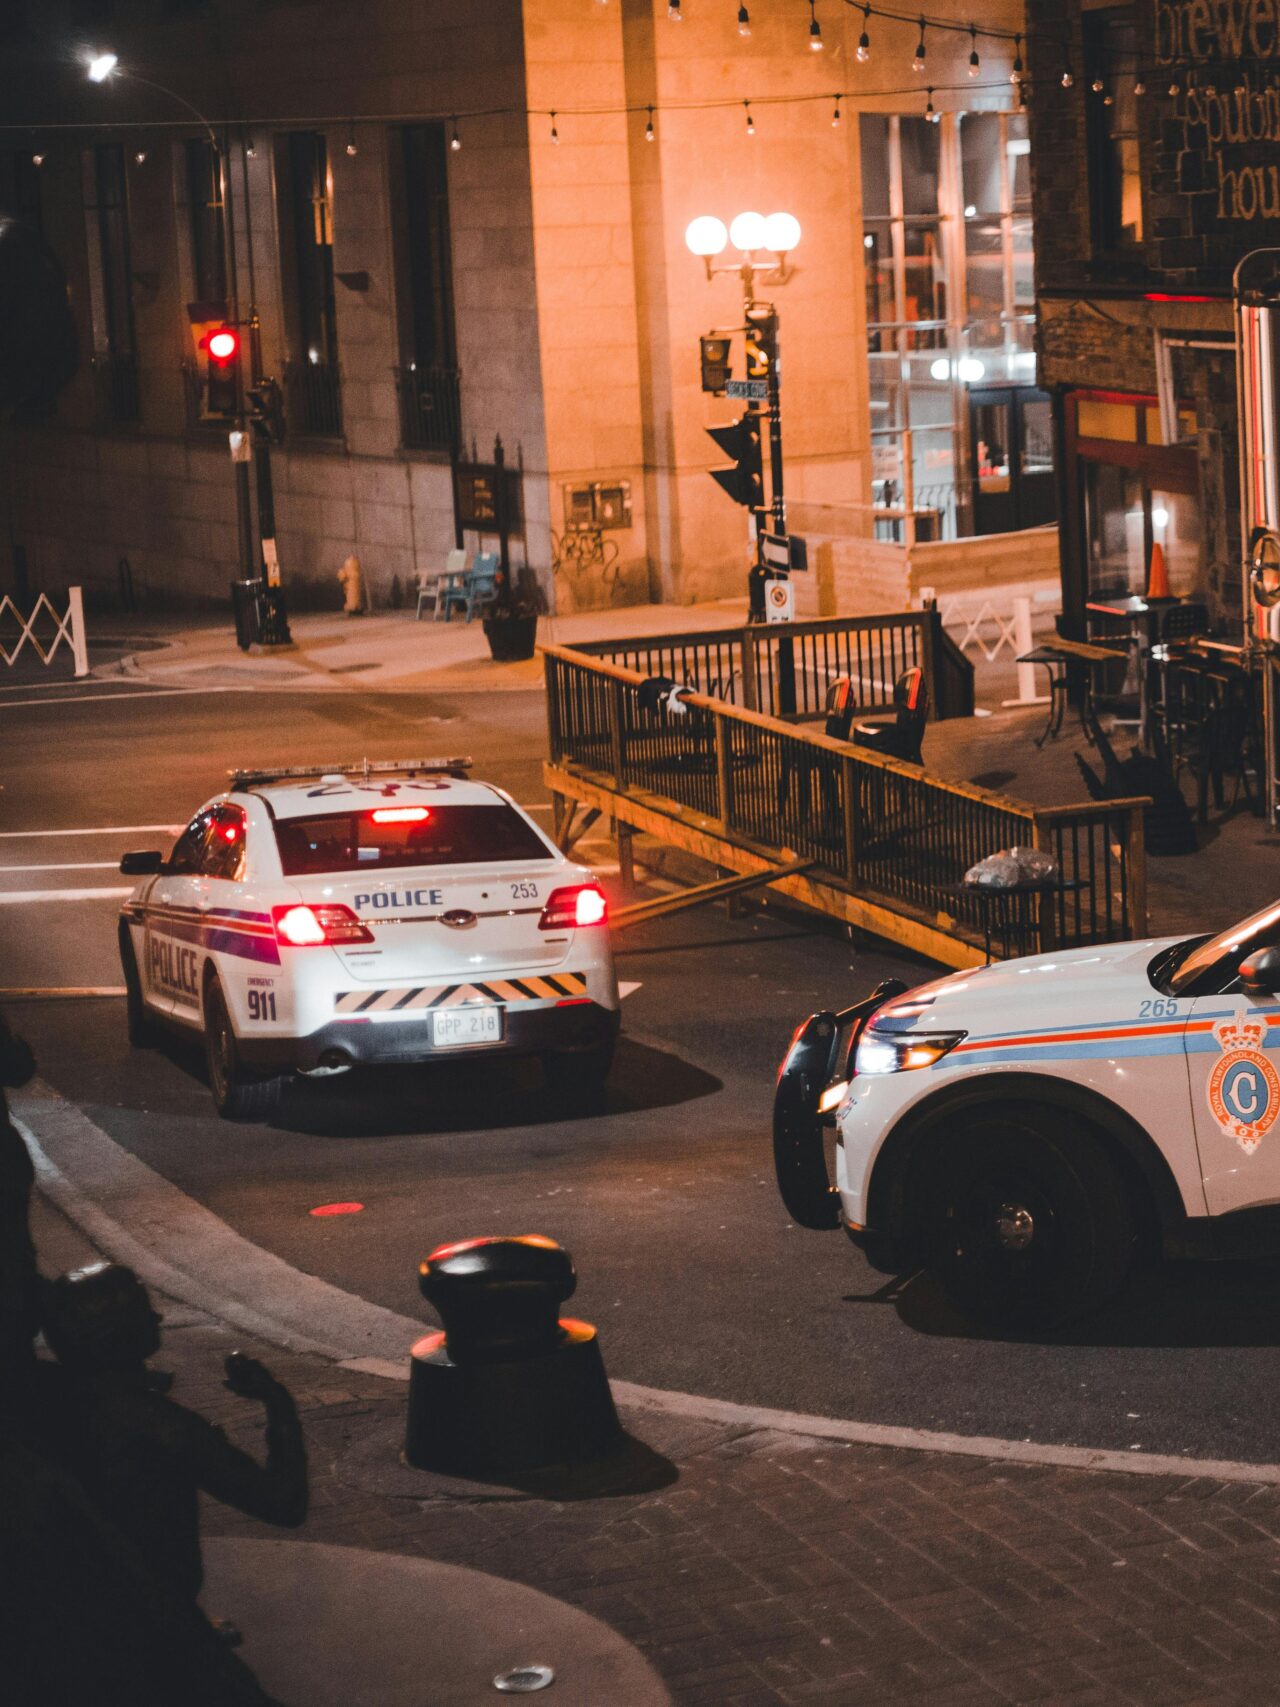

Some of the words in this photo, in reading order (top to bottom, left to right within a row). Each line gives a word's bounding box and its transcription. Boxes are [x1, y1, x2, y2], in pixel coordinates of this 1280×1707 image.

[354, 889, 443, 910] POLICE
[510, 883, 539, 899] 253
[149, 936, 199, 996] POLICE
[248, 990, 277, 1021] 911
[1139, 999, 1178, 1018] 265
[470, 1016, 495, 1033] 218
[1227, 1071, 1258, 1114] C
